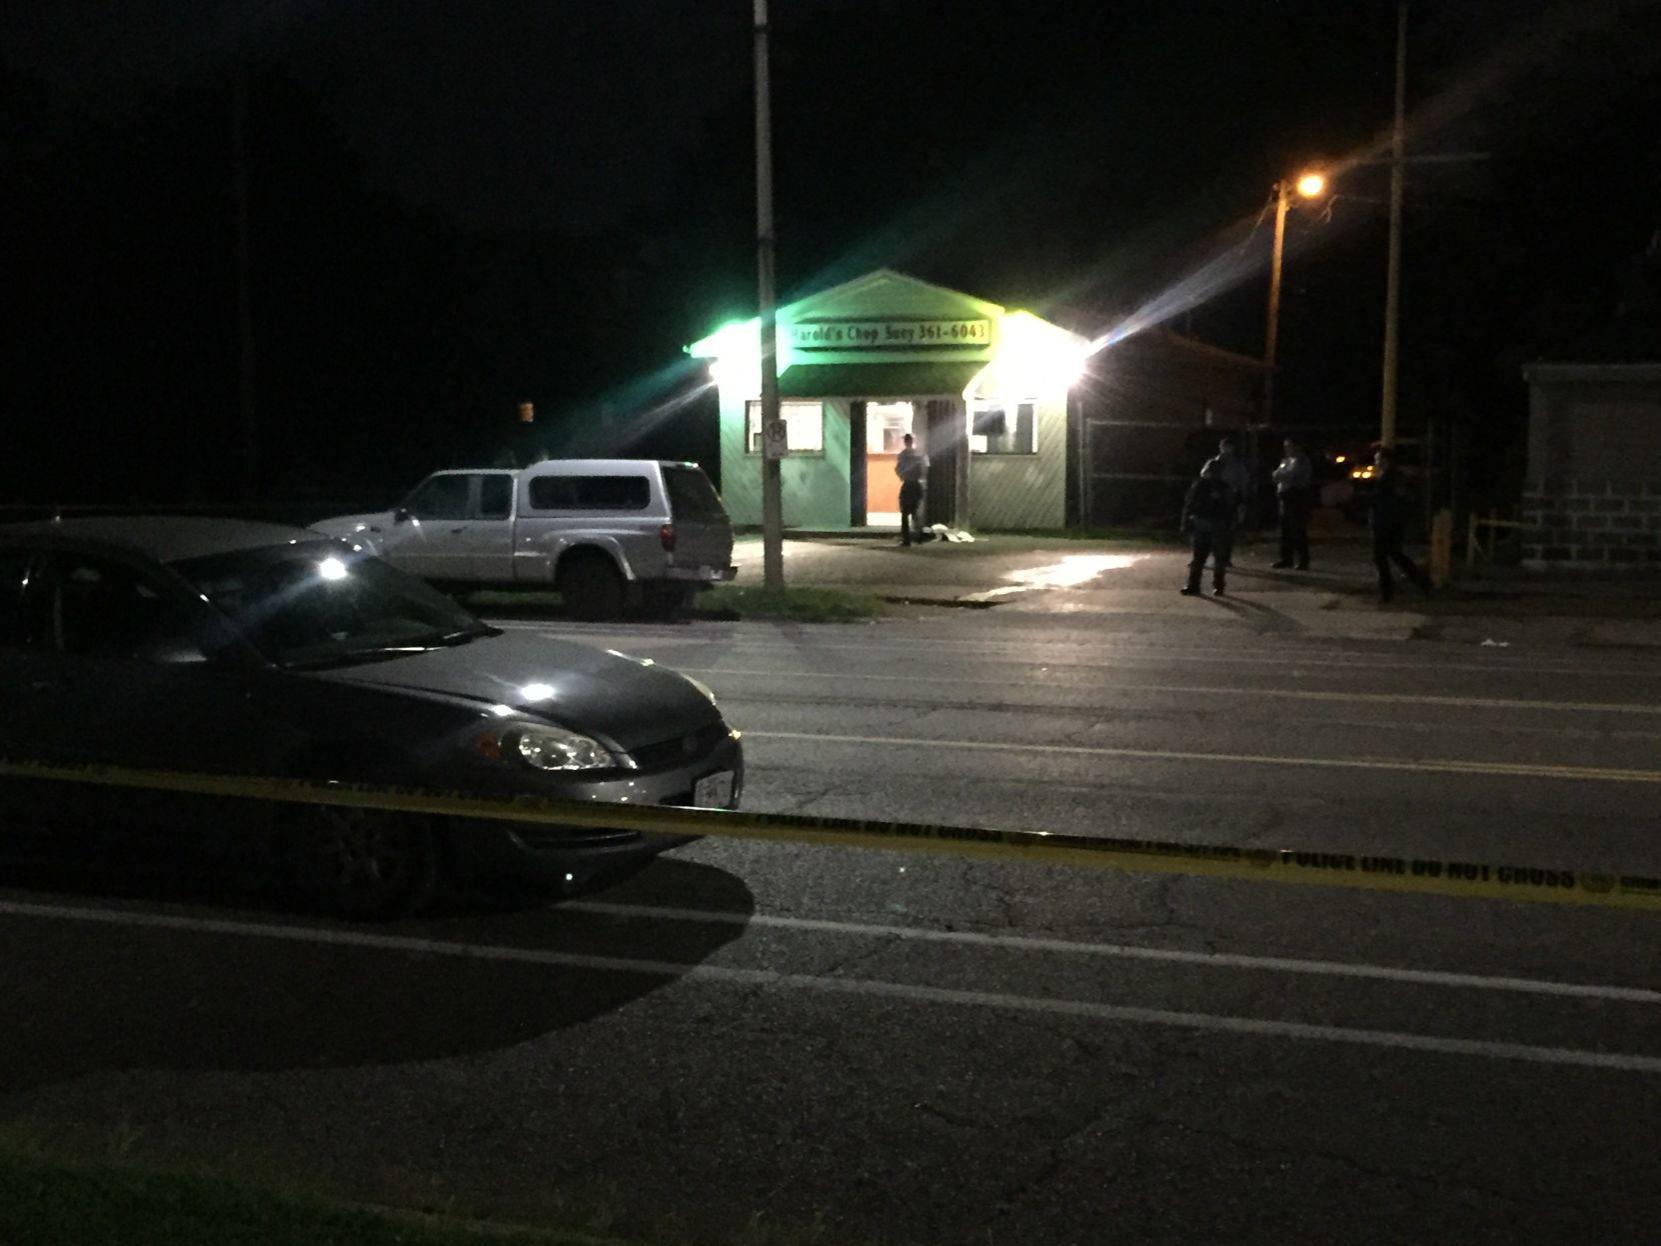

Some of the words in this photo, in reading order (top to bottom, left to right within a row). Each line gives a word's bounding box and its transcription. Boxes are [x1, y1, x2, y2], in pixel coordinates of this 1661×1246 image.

[847, 326, 879, 343] Chop
[886, 325, 914, 342] Suey
[919, 323, 985, 339] 361-6043
[1280, 850, 1356, 871] POLICE
[1361, 856, 1406, 875] LINE
[1411, 859, 1442, 878] DO
[1448, 863, 1489, 882] NOT
[1497, 865, 1575, 888] CROSS
